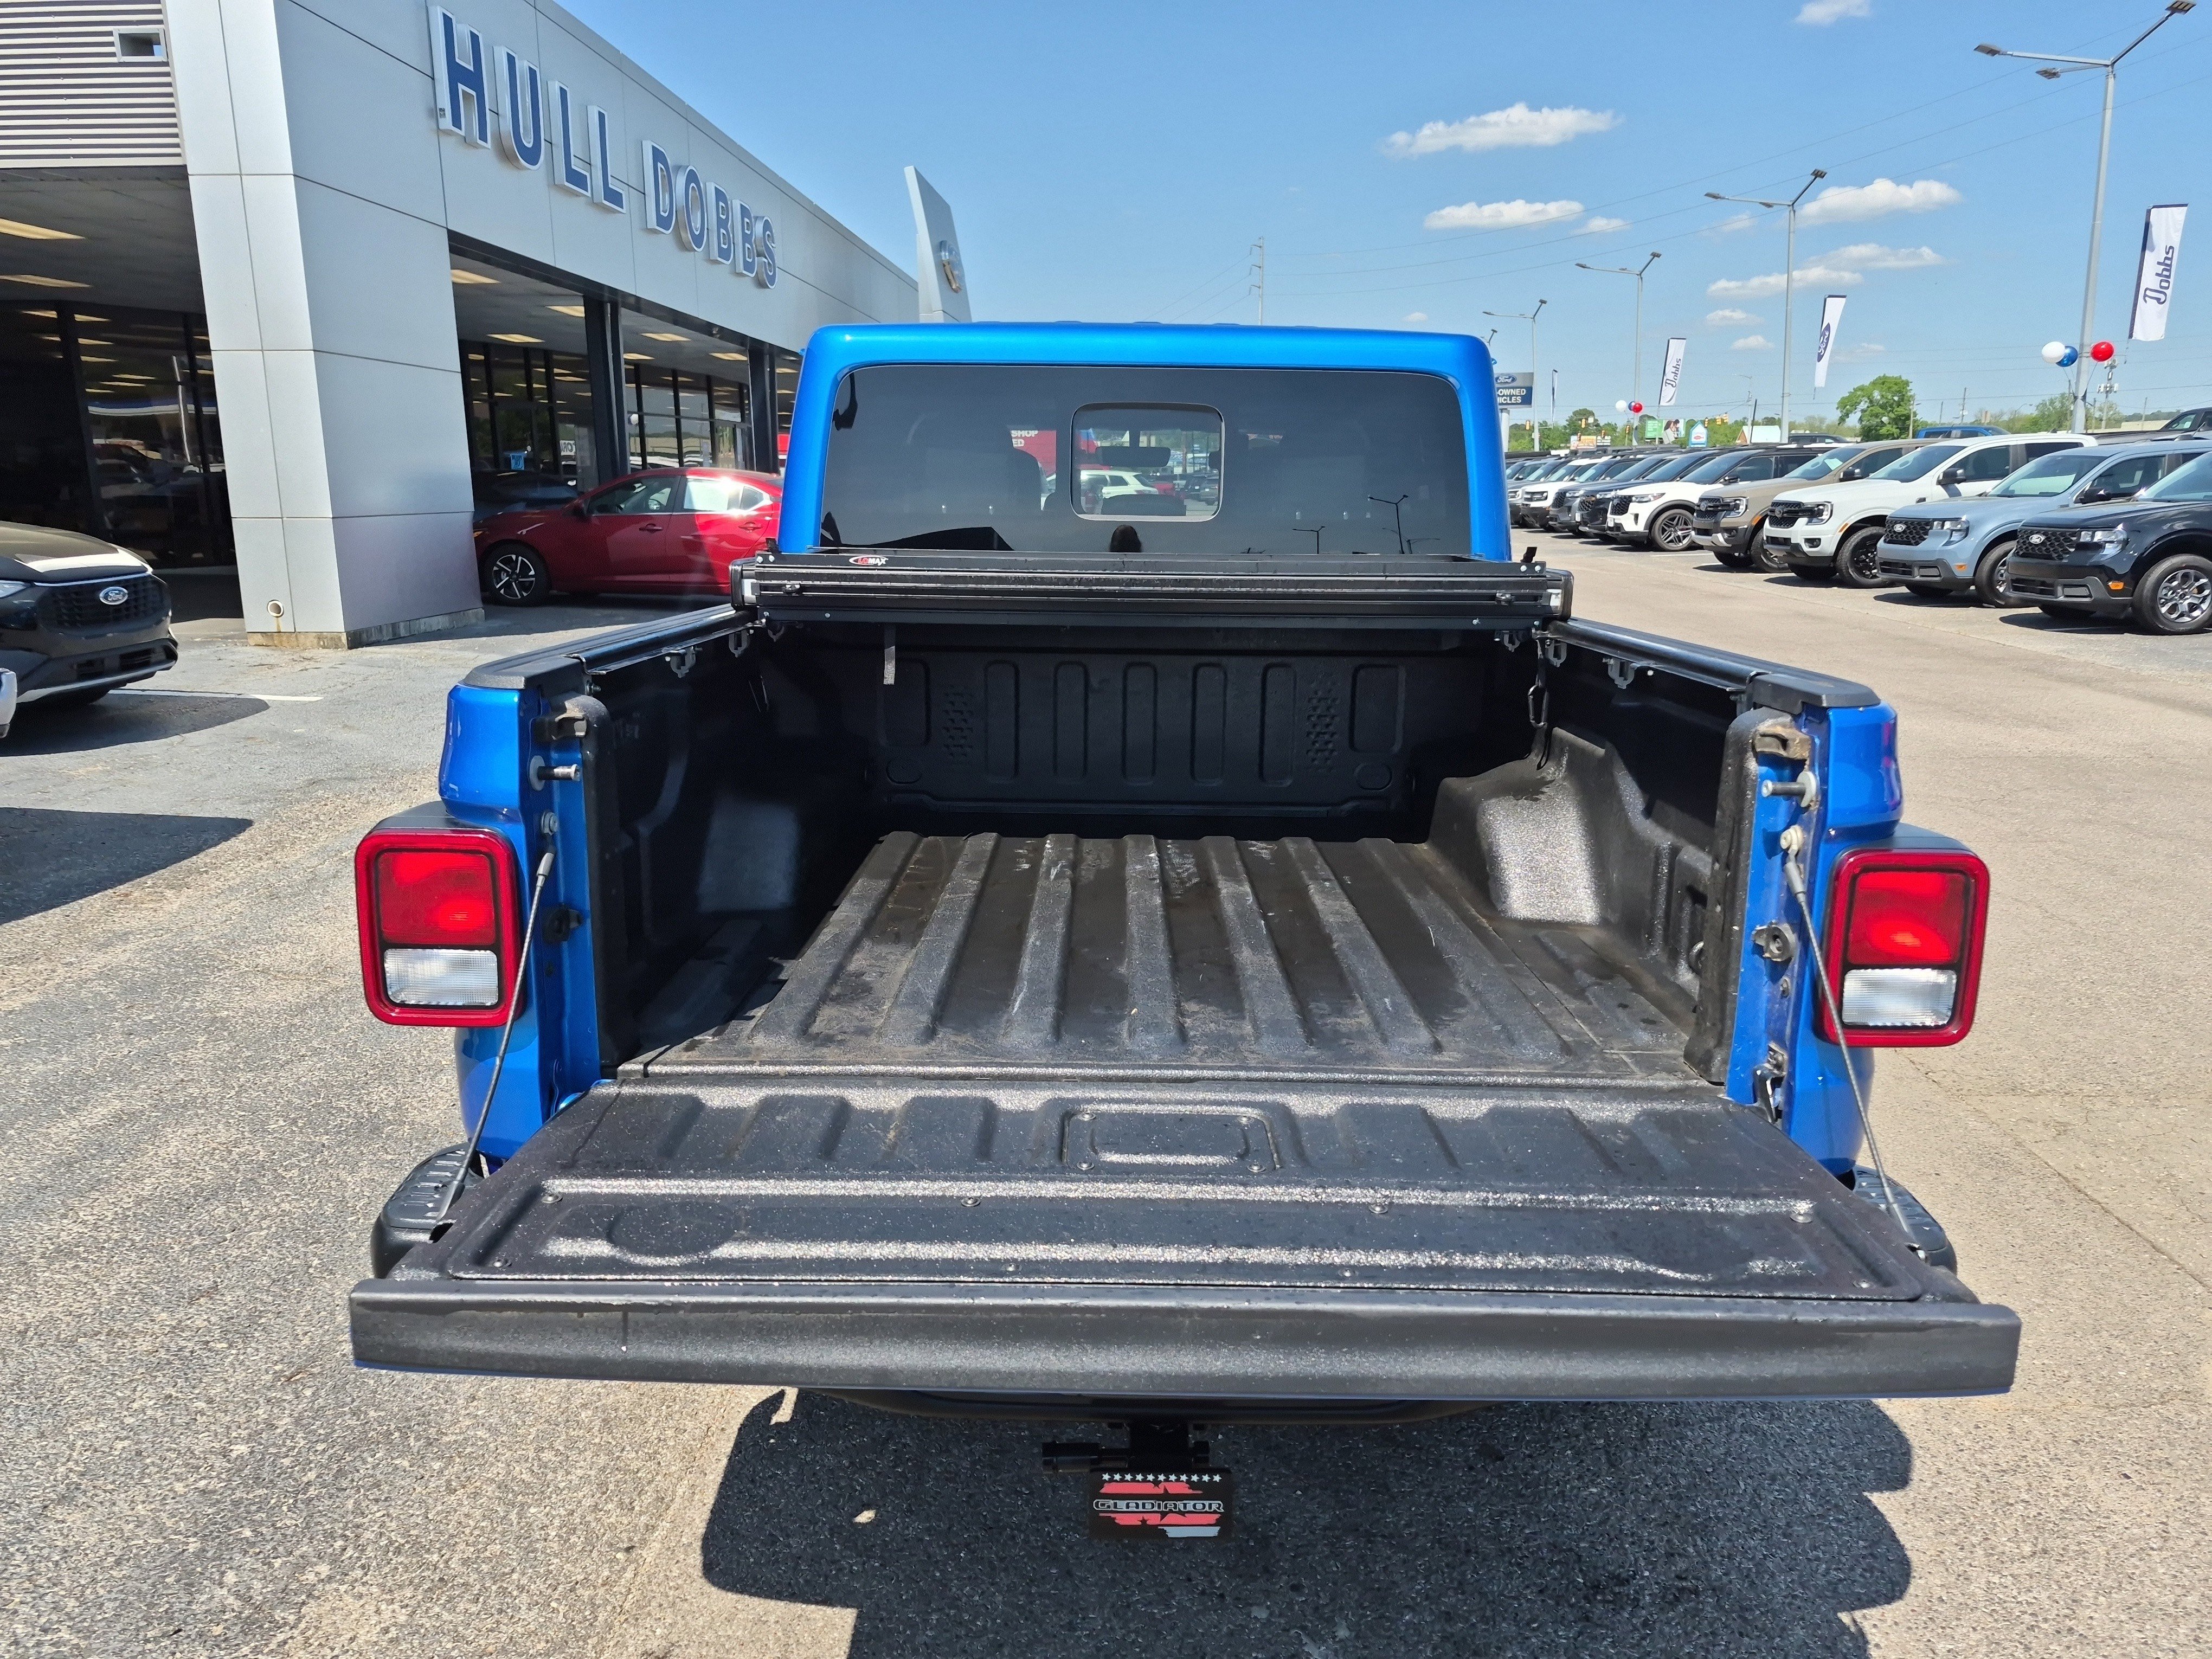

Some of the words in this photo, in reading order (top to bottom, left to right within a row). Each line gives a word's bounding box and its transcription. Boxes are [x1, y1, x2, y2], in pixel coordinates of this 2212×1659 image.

[430, 5, 626, 214] HULL
[642, 140, 777, 290] DOBBS
[2143, 245, 2175, 305] Dobbs
[1665, 358, 1681, 388] Dobbs
[858, 557, 888, 566] LOMAX
[1093, 1499, 1224, 1512] GLADIATOR
